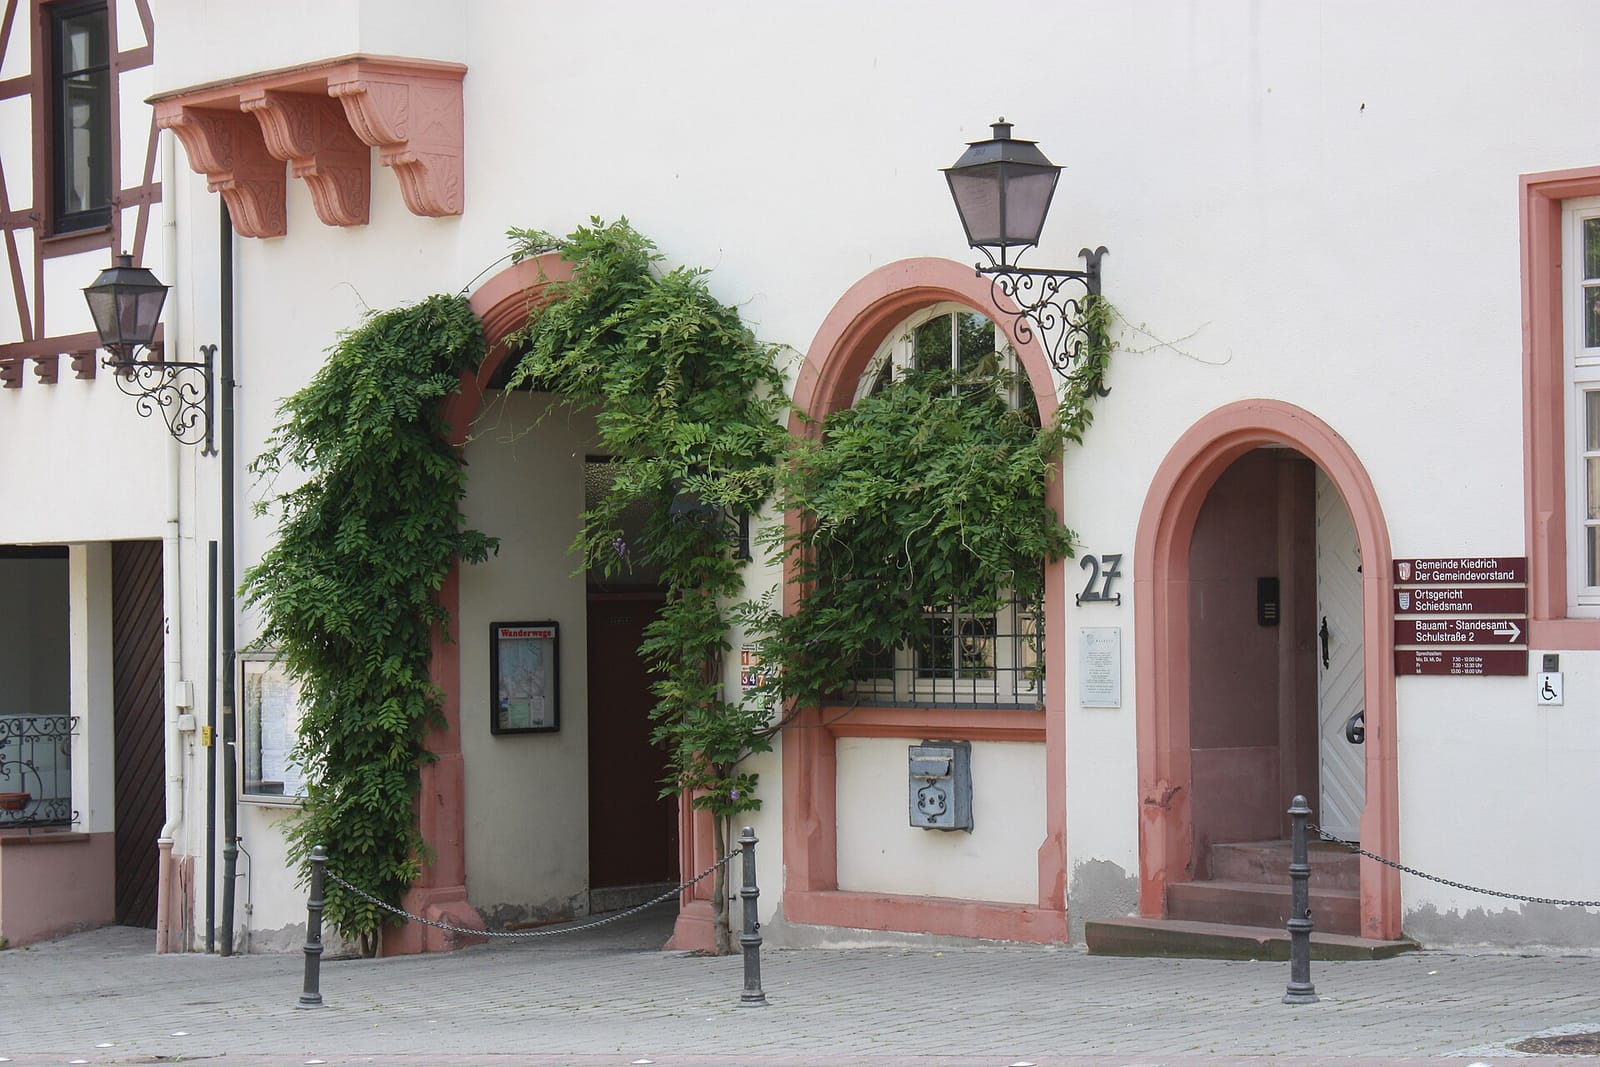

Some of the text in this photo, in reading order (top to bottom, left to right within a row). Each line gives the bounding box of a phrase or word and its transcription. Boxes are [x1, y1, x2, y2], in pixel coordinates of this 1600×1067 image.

[1415, 559, 1497, 569] Gemeinde Kiedrich
[1080, 554, 1122, 601] 27
[1415, 570, 1514, 581] Der Gemeindevorstand
[1414, 590, 1463, 600] Ortsgericht
[1415, 601, 1473, 611] Schiedsmann
[1415, 621, 1447, 630] Bauamt
[1455, 620, 1508, 630] Standesamt
[1416, 632, 1475, 642] Schulstraße 2
